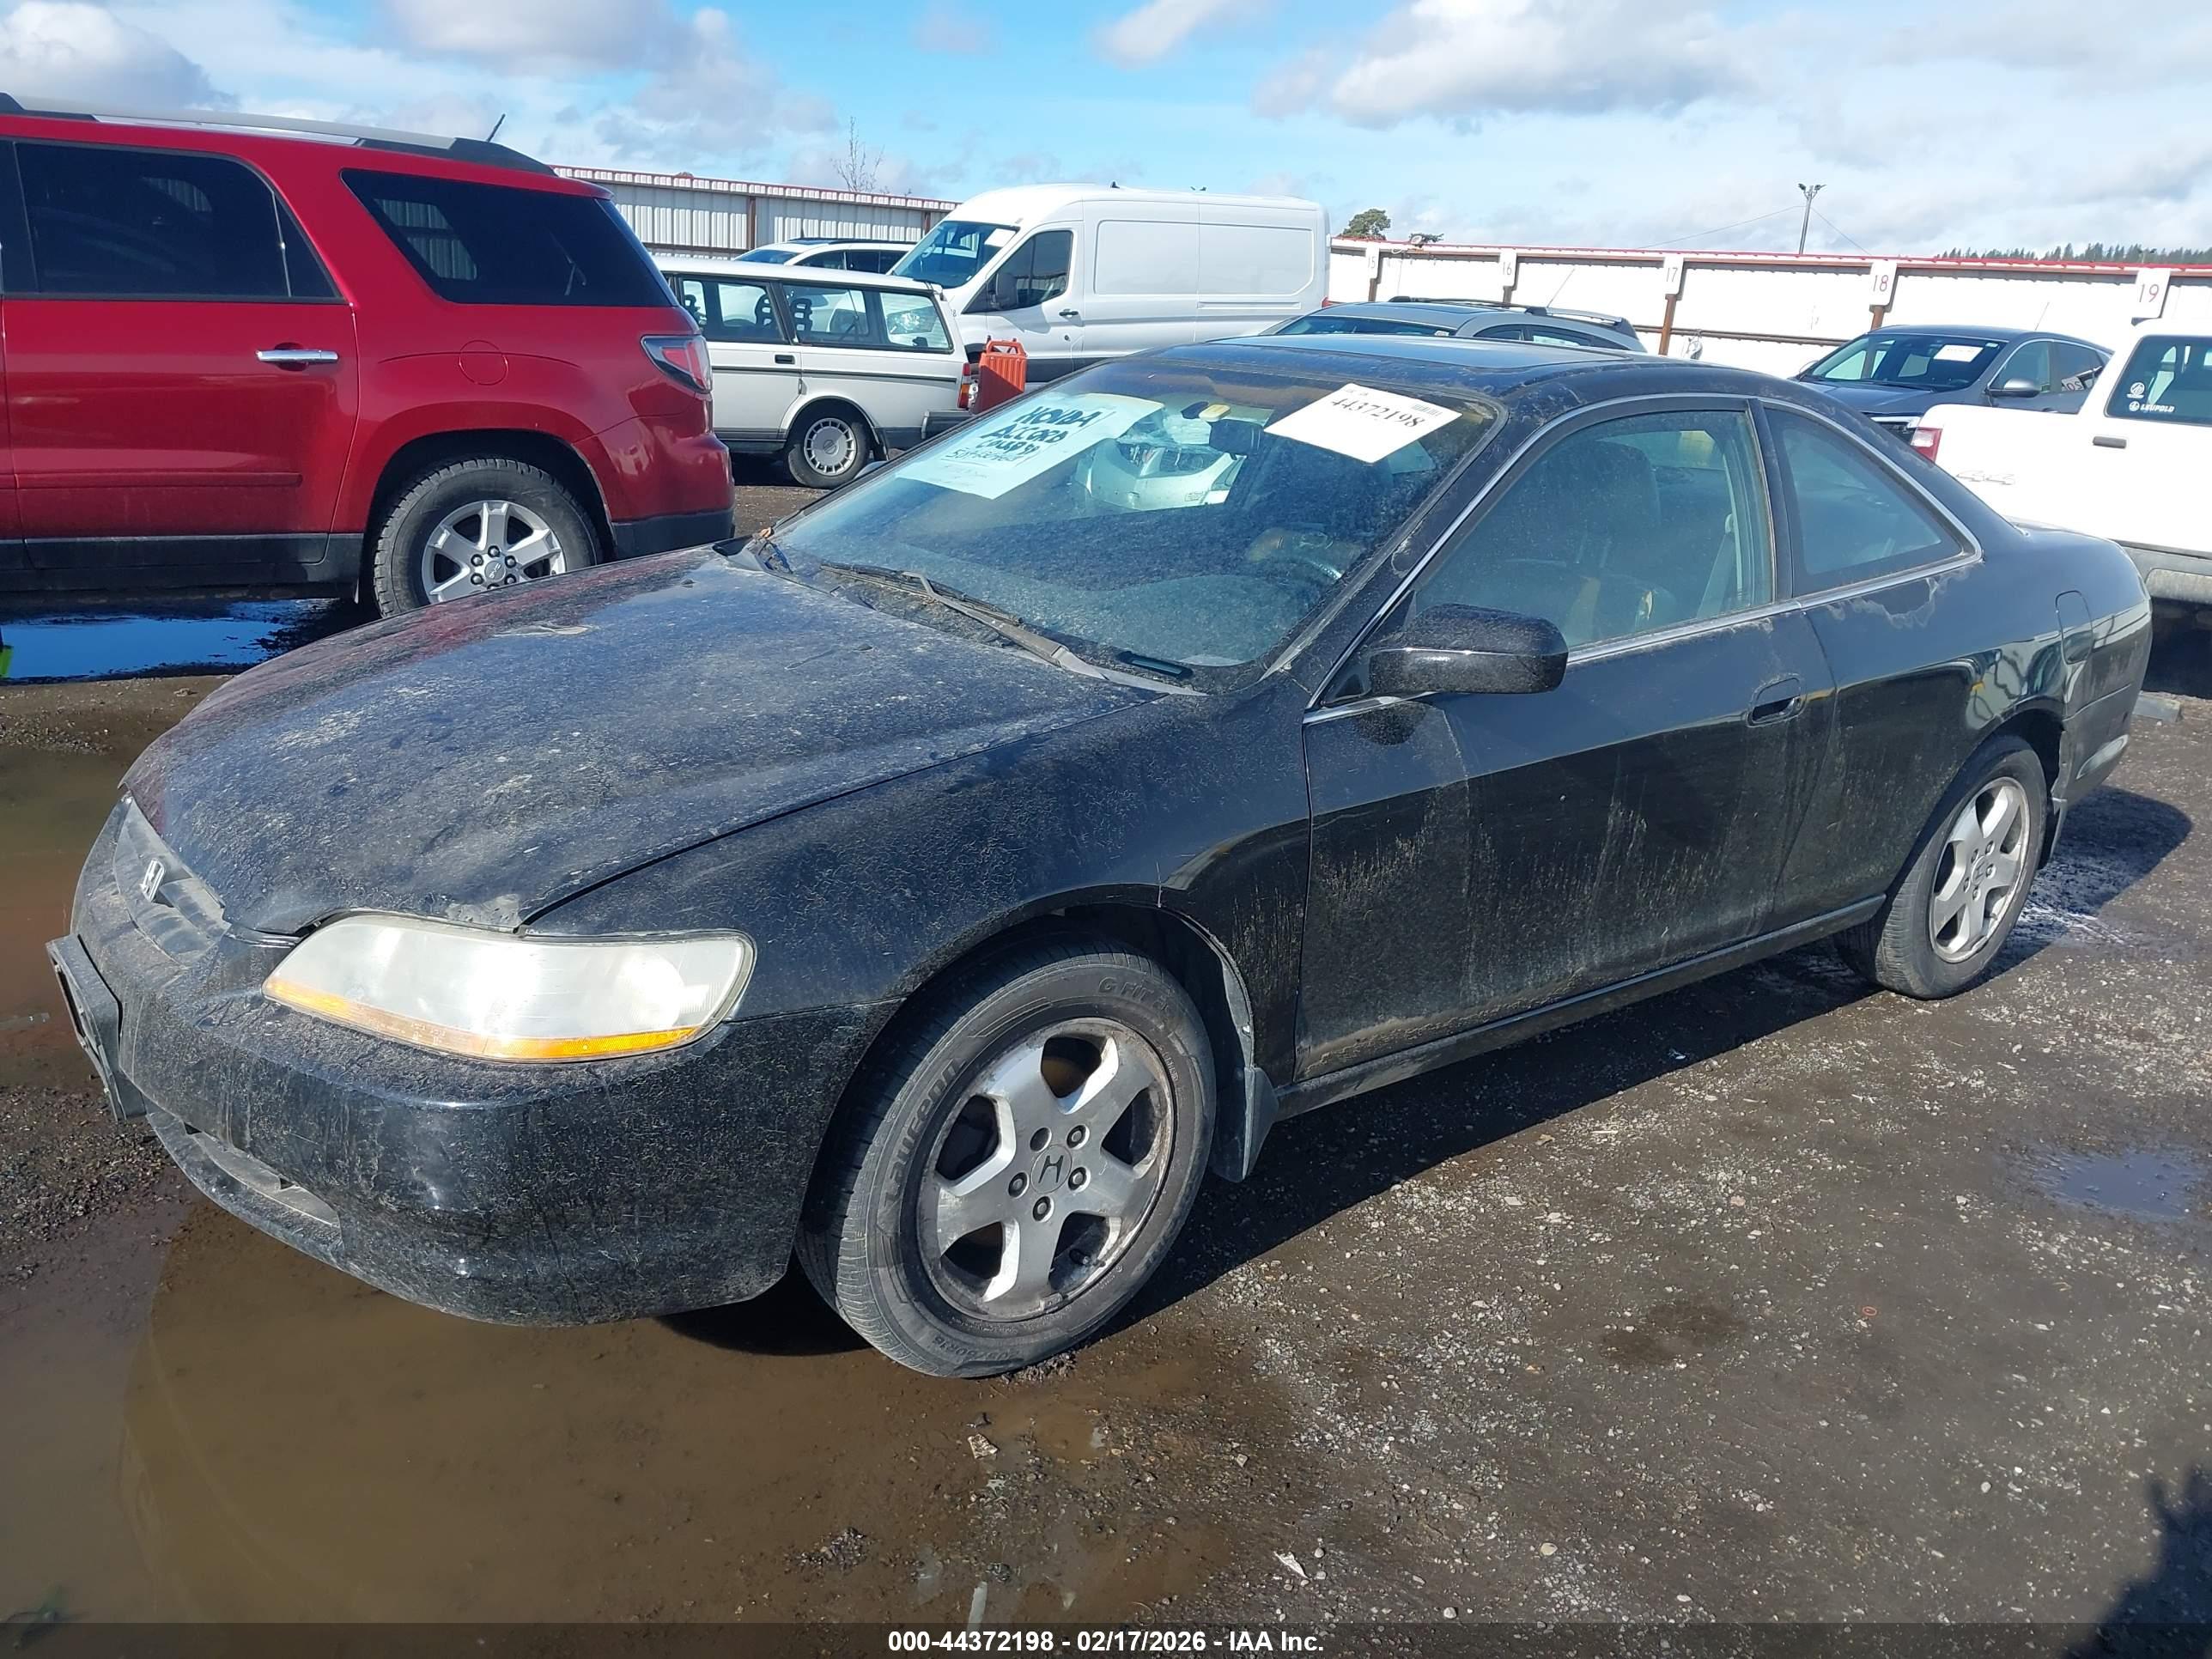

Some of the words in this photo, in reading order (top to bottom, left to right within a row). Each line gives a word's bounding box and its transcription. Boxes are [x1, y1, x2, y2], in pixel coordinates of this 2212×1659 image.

[1367, 256, 1376, 270] 15
[1502, 261, 1512, 276] 16
[1666, 266, 1679, 283] 17
[1873, 274, 1889, 293] 18
[2138, 283, 2160, 303] 19
[1013, 405, 1103, 428] HONDA
[1330, 397, 1426, 428] 44372198
[2140, 403, 2175, 413] LEUPOLD
[981, 424, 1070, 445] ACCORD
